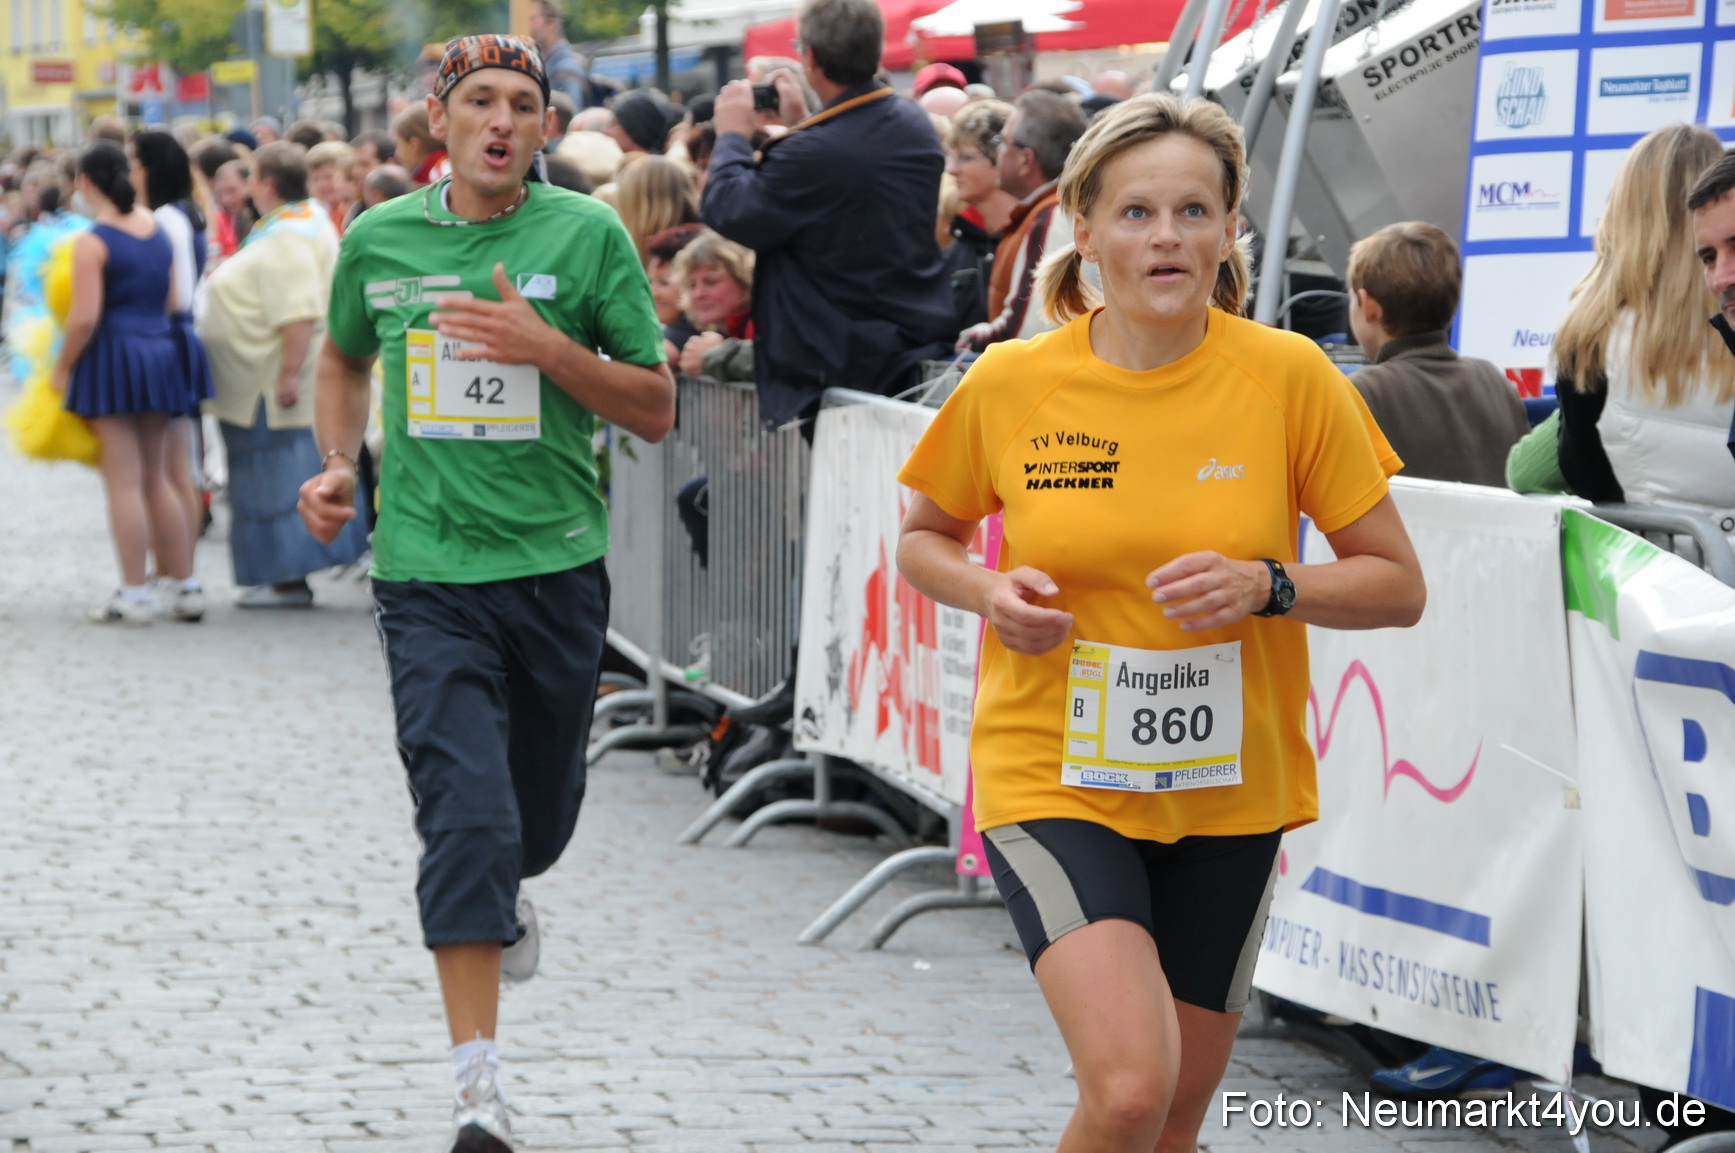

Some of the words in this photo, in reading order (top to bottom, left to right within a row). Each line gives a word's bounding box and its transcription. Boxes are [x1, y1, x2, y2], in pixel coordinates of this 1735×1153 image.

[1363, 6, 1482, 88] SPORTR
[1603, 80, 1651, 93] Neumarkter
[1652, 78, 1688, 92] Tagblatt
[1479, 181, 1532, 204] MCM
[412, 371, 420, 386] A
[465, 376, 505, 404] 42
[1030, 433, 1050, 451] TV
[1055, 431, 1119, 456] Velburg
[1038, 461, 1120, 475] INTERSPORT
[1026, 477, 1114, 490] HACKNER
[1116, 661, 1209, 696] Angelika
[1073, 698, 1084, 718] B
[1131, 704, 1213, 746] 860
[1174, 777, 1238, 789] AKTIENGESELLSCHAFT
[1175, 764, 1237, 781] PFLEIDERER
[1338, 940, 1502, 1022] KASSENSYSTEME
